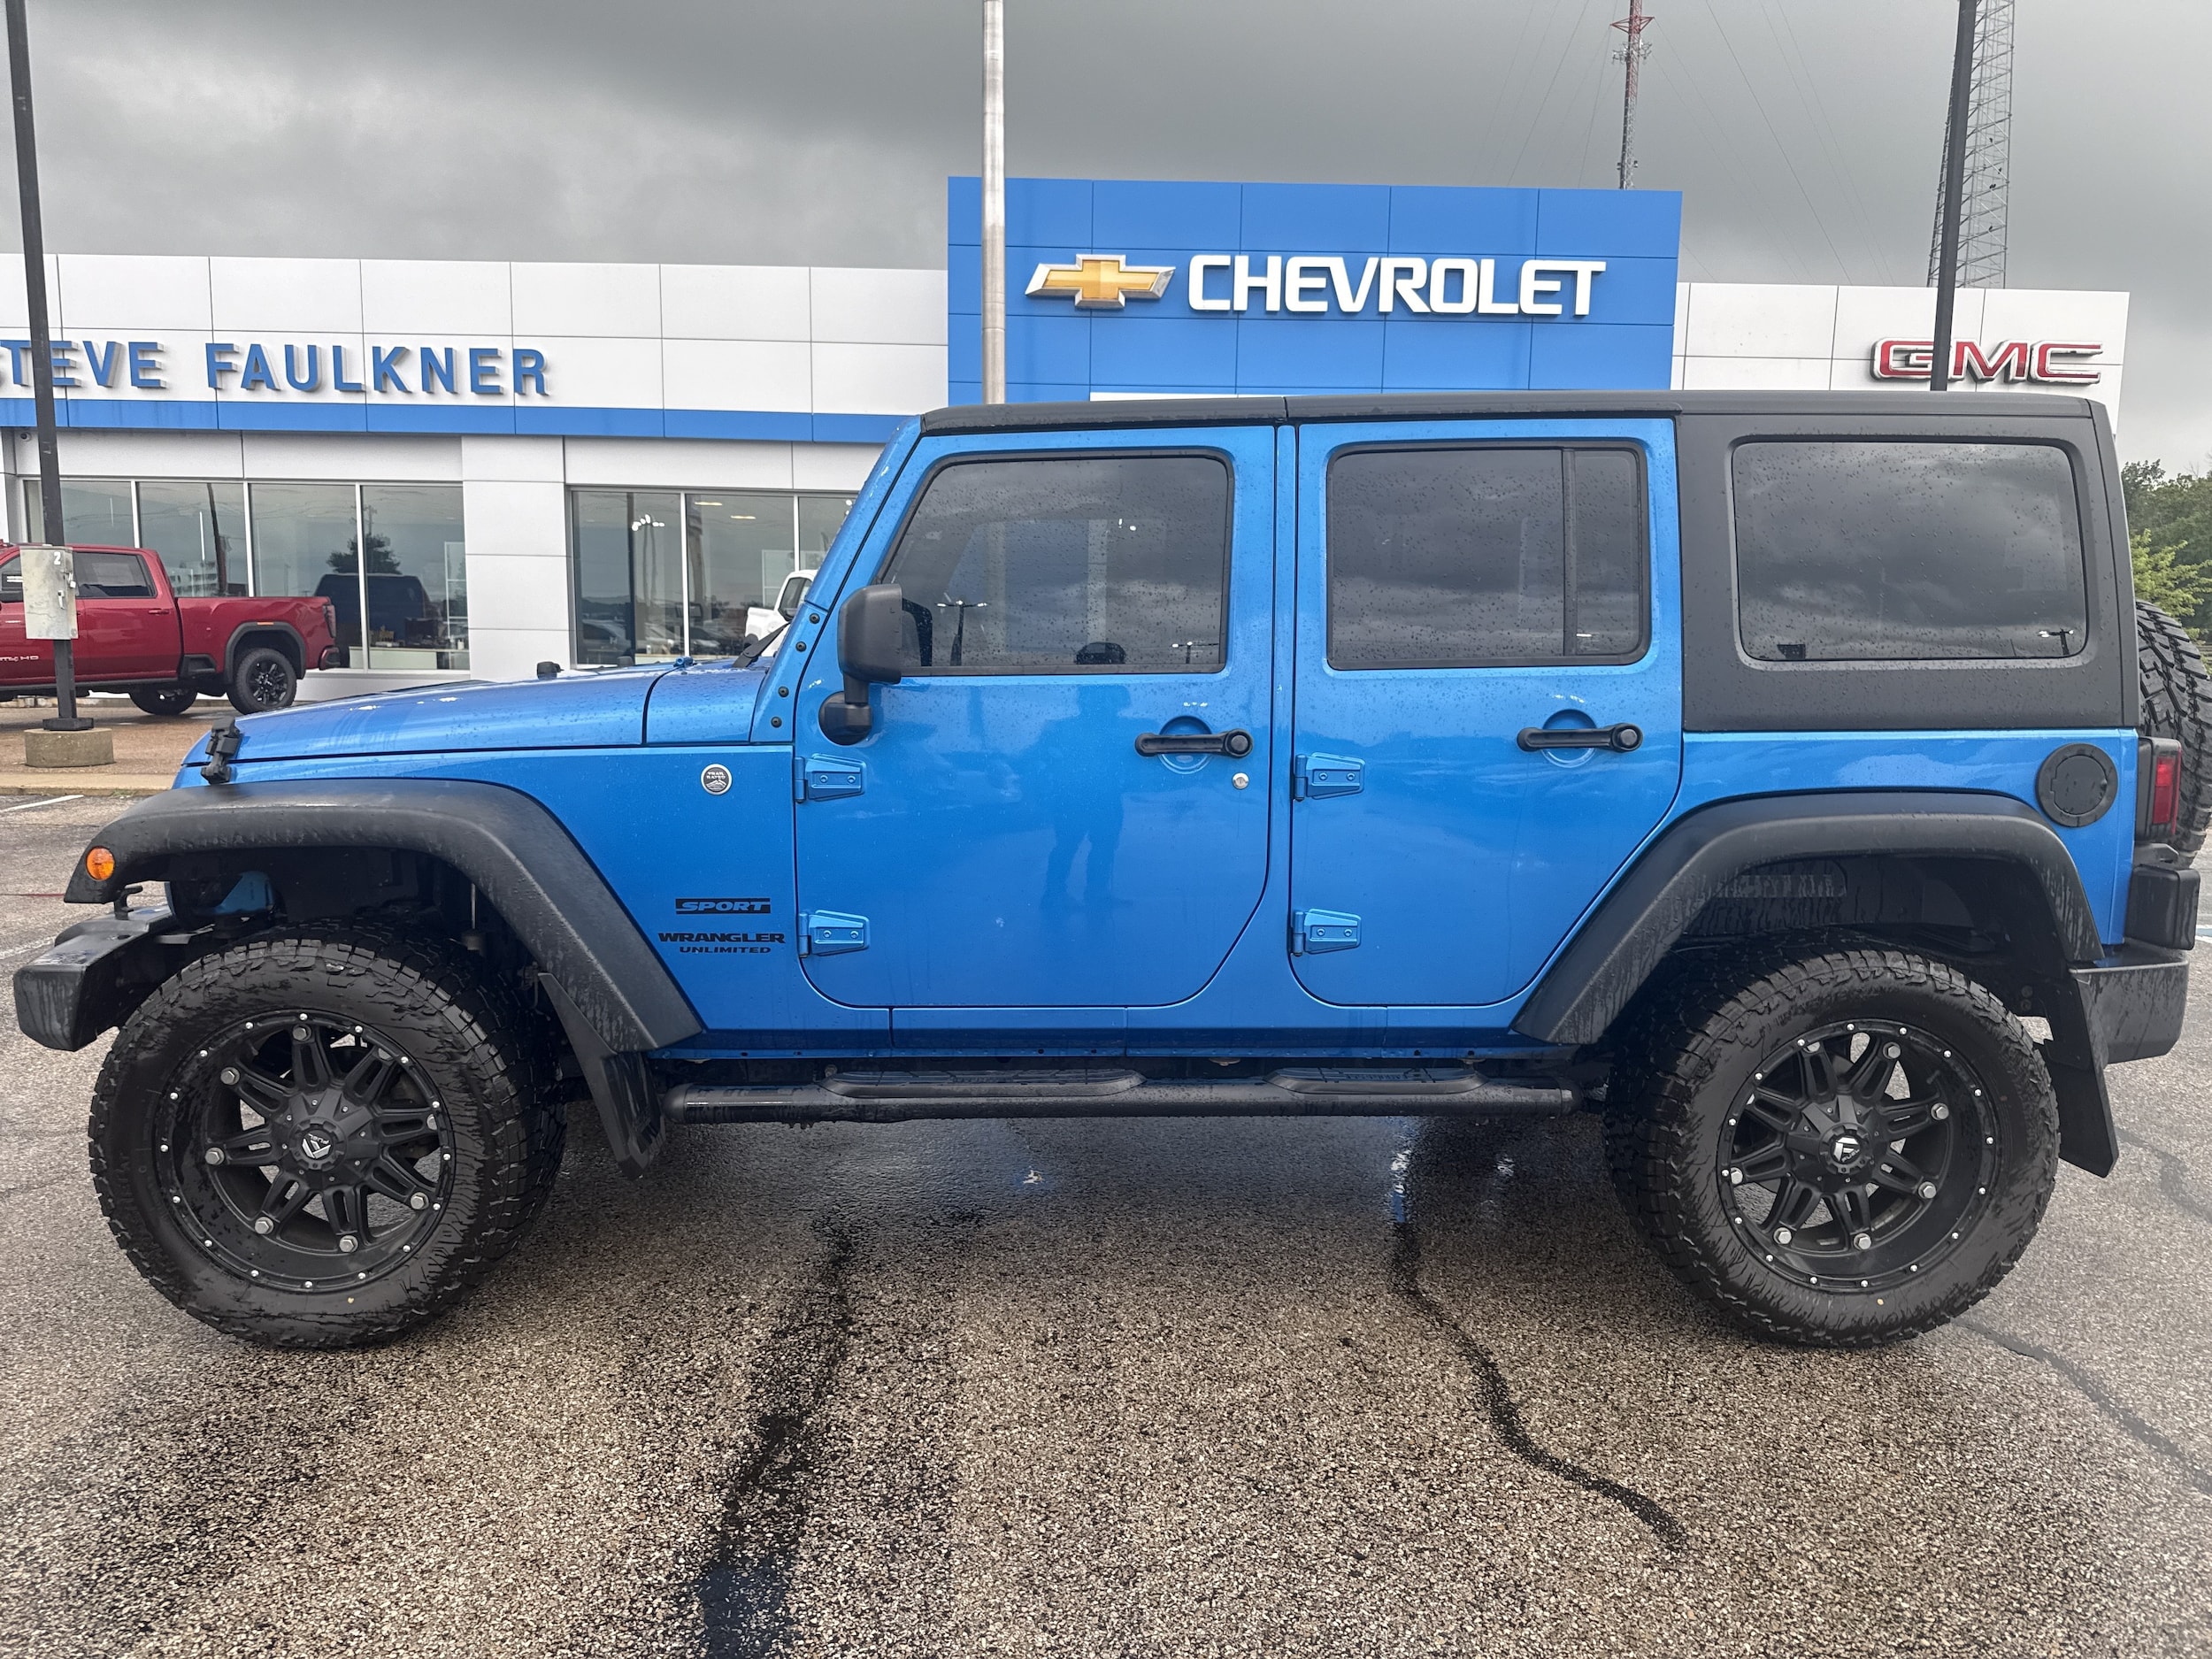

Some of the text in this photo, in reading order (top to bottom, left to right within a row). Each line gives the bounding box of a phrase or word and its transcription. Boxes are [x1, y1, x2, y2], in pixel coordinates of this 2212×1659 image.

[1187, 255, 1607, 316] CHEVROLET
[0, 340, 549, 396] TEVE FAULKNER
[1872, 338, 2102, 384] GMC
[54, 551, 61, 565] 2
[676, 901, 771, 912] SPORT
[657, 933, 787, 944] WRANGLER
